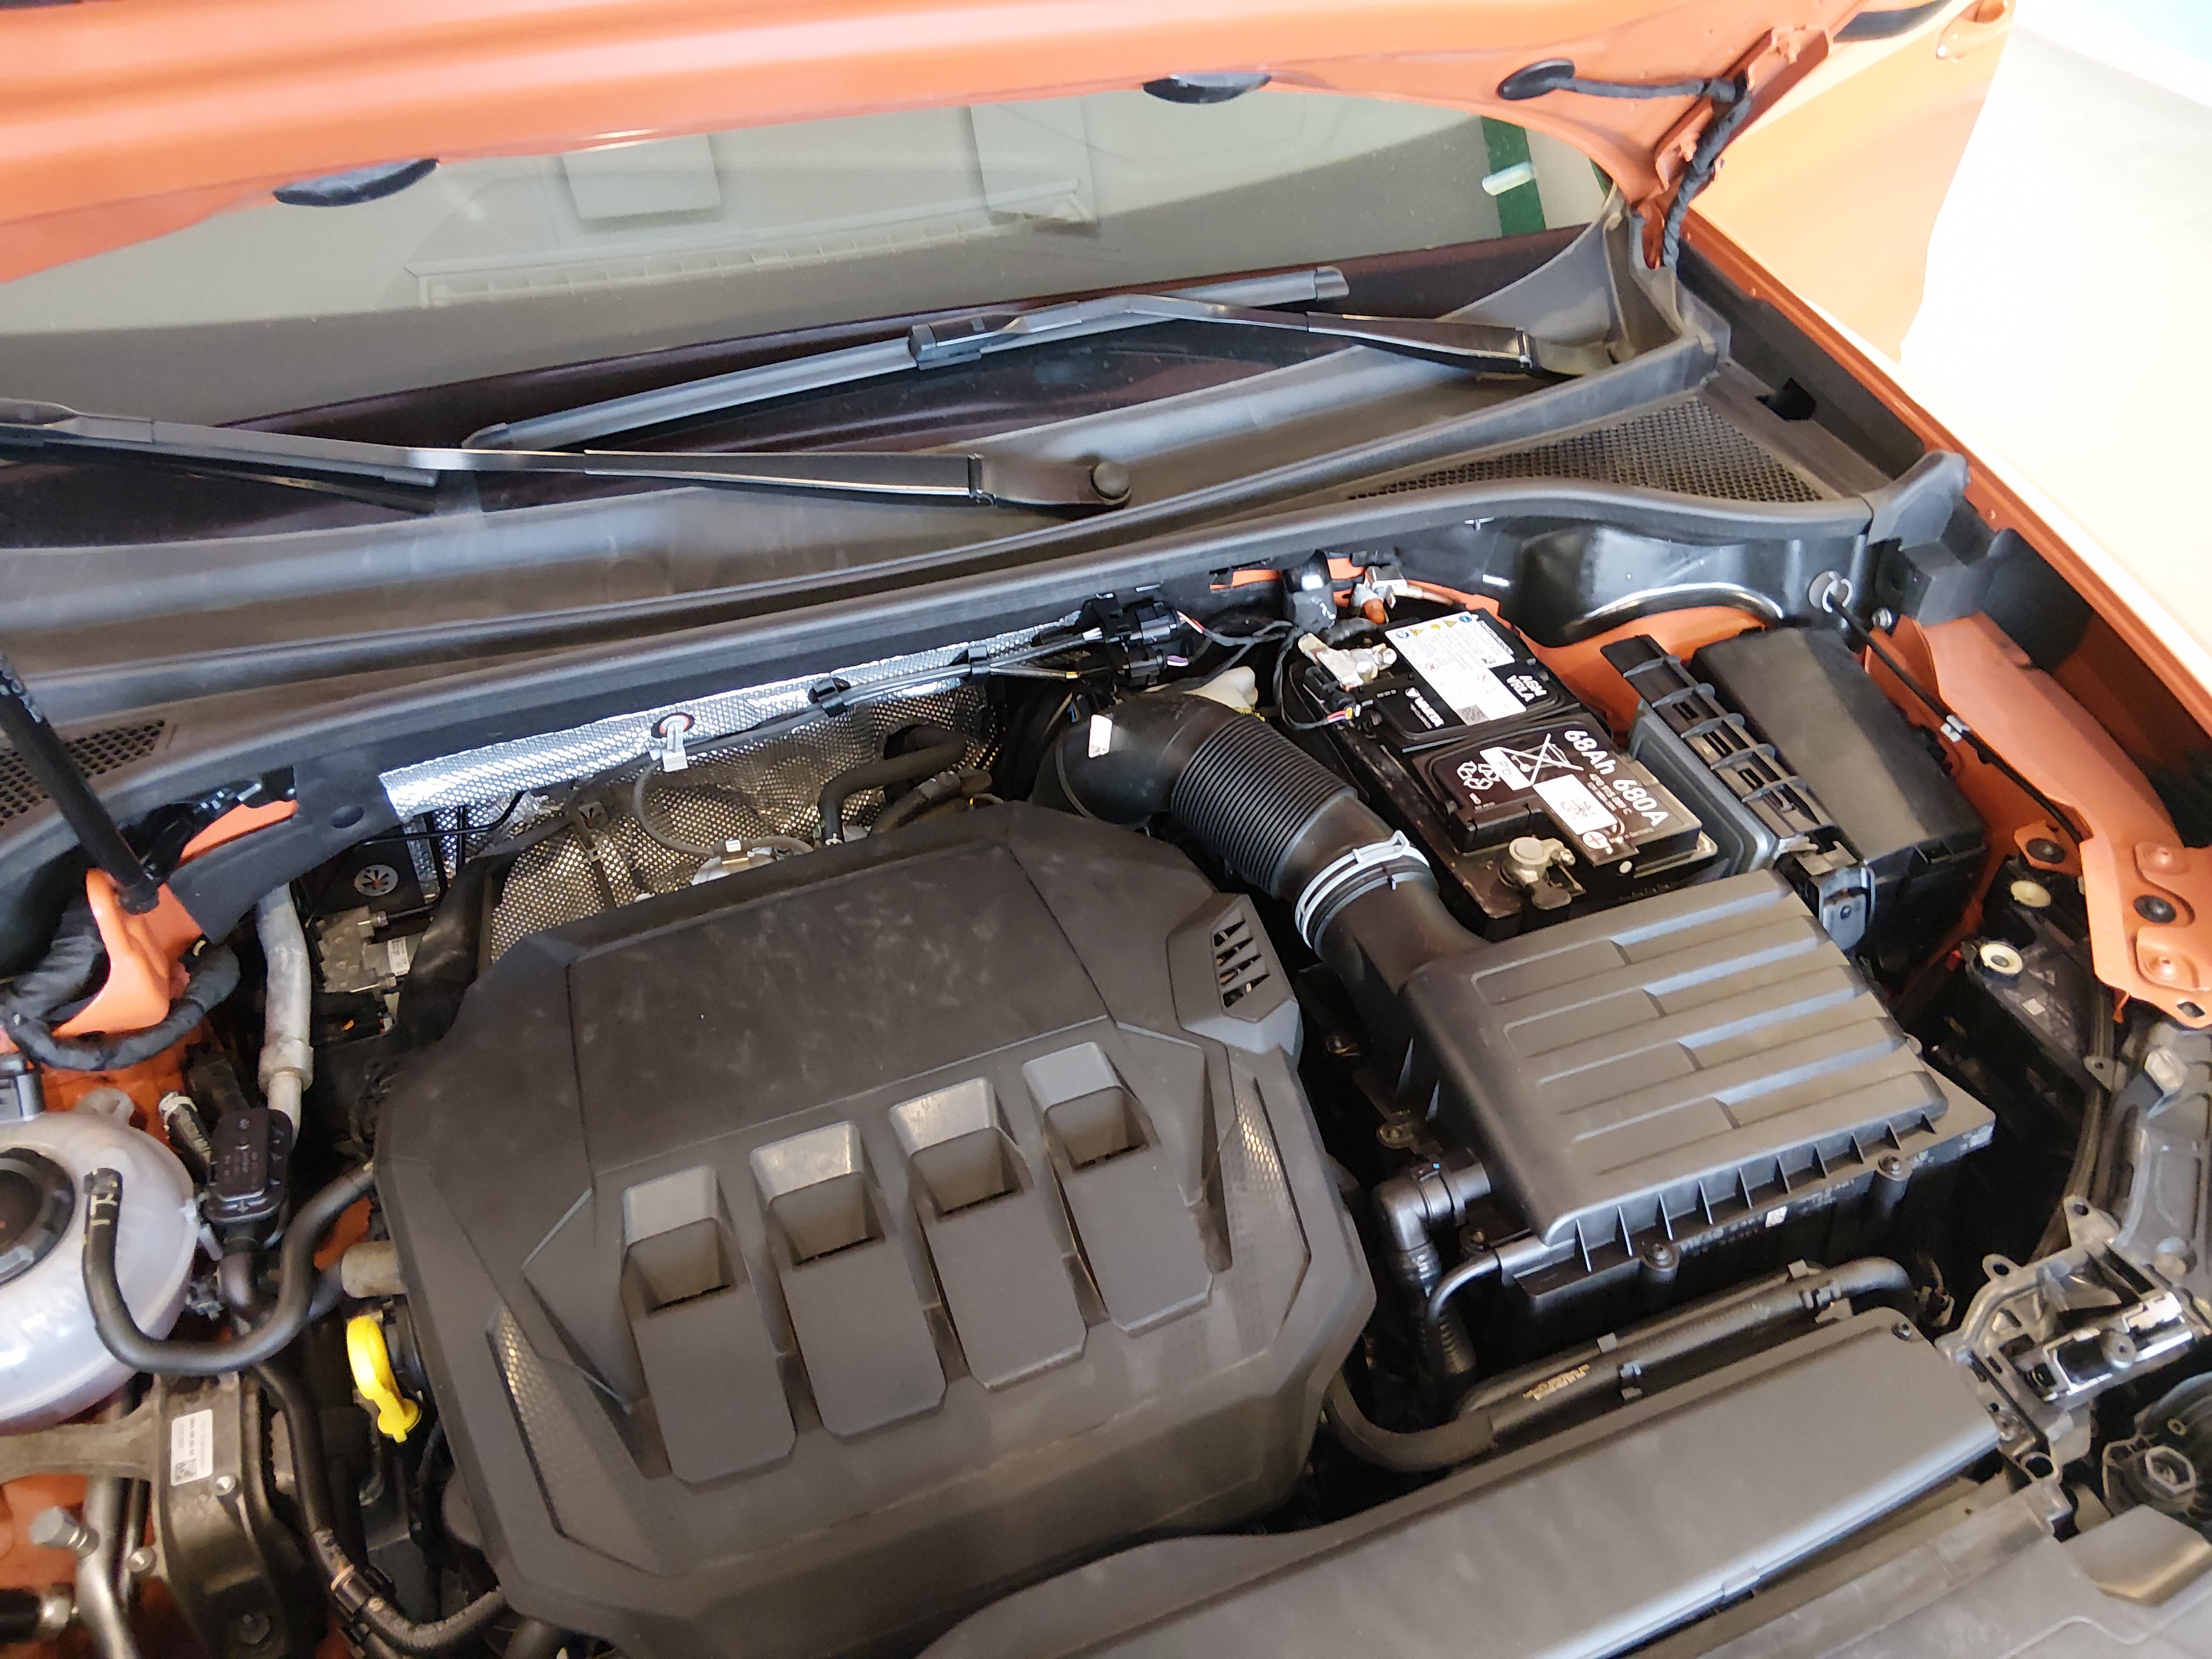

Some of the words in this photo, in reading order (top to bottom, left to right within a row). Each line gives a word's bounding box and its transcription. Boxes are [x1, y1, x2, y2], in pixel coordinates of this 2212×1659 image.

[1518, 675, 1547, 696] AGM
[1564, 730, 1616, 775] 68Ah
[1612, 779, 1669, 827] 680A
